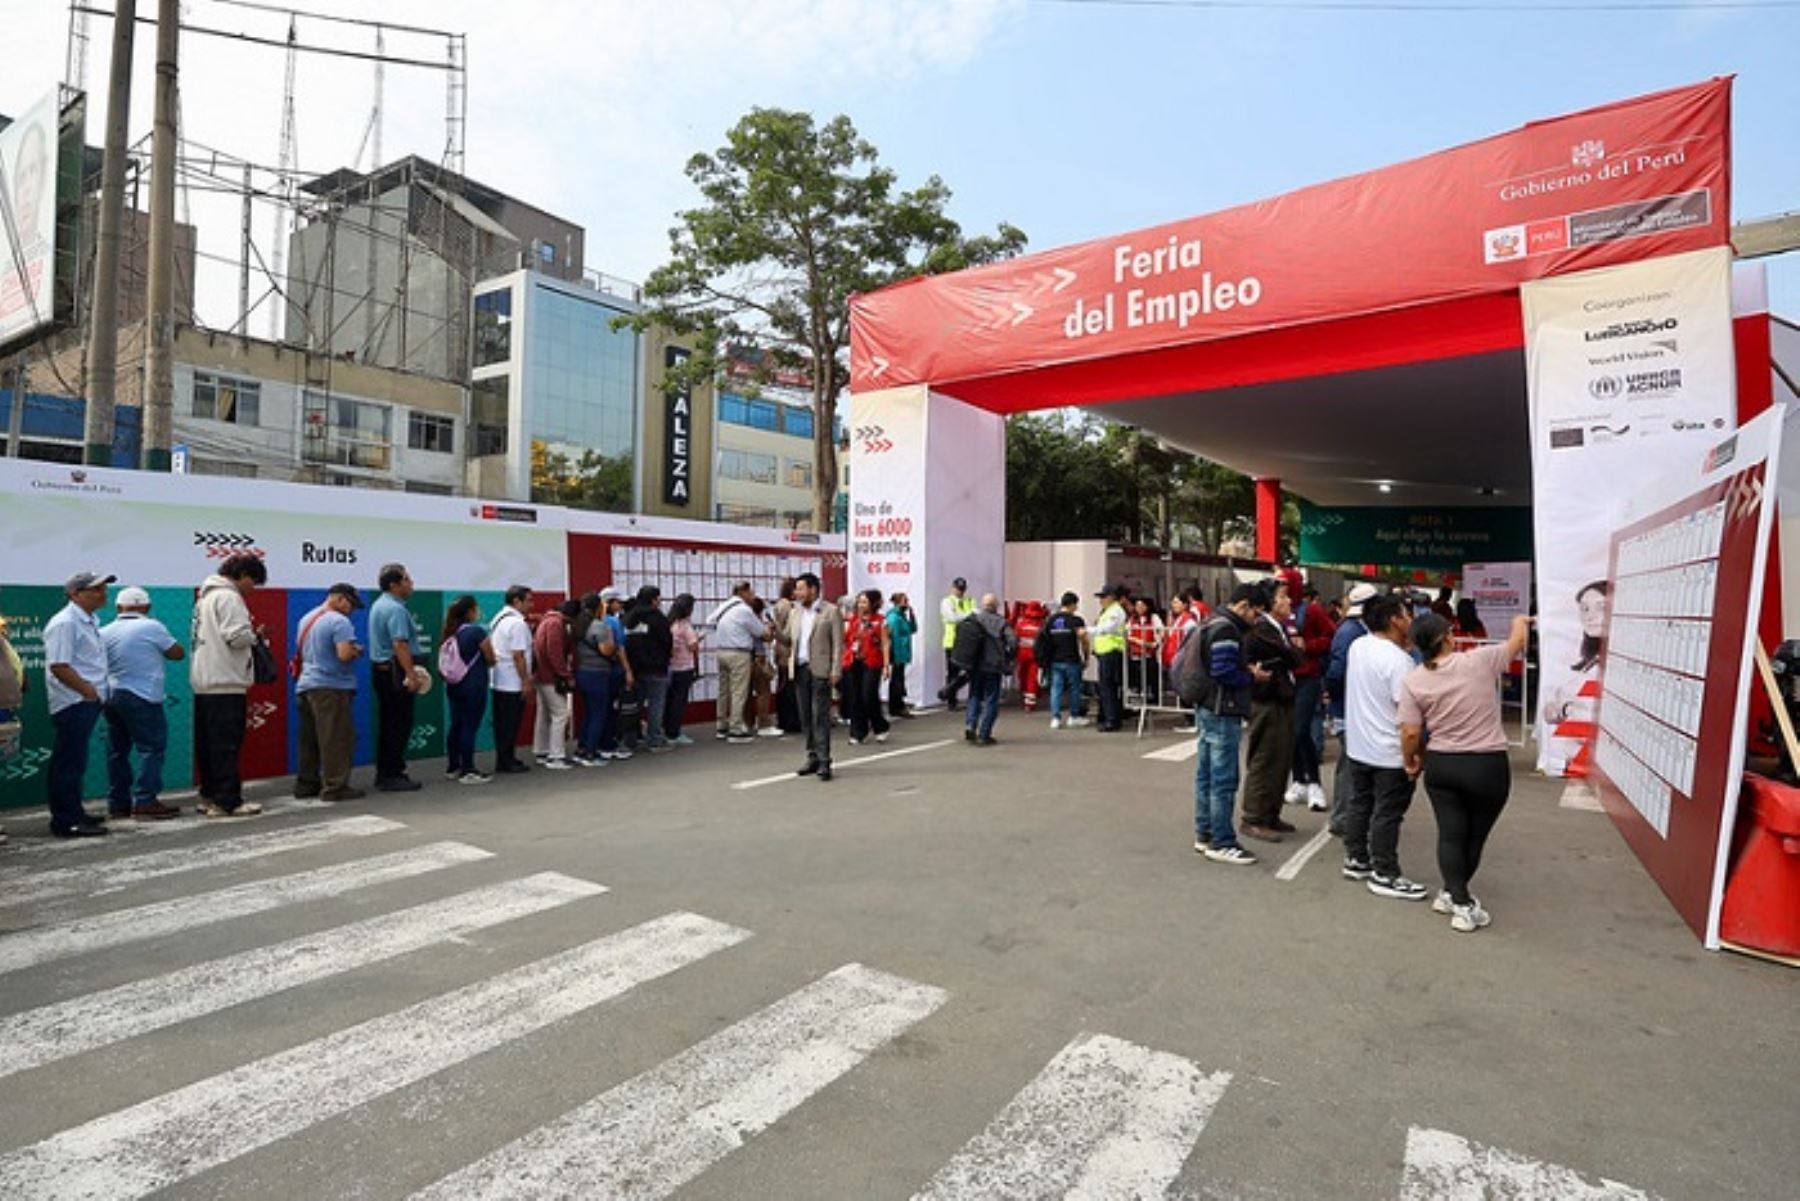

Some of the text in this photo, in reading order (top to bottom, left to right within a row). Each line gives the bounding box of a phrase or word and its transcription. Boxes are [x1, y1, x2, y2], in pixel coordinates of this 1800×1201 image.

[1499, 147, 1685, 201] Gobierno del Perú
[1114, 235, 1201, 283] Feria
[1064, 271, 1261, 338] del Empleo
[855, 517, 912, 537] las 6000
[302, 541, 357, 563] Rutas
[854, 539, 910, 553] vacantes
[868, 562, 881, 574] es
